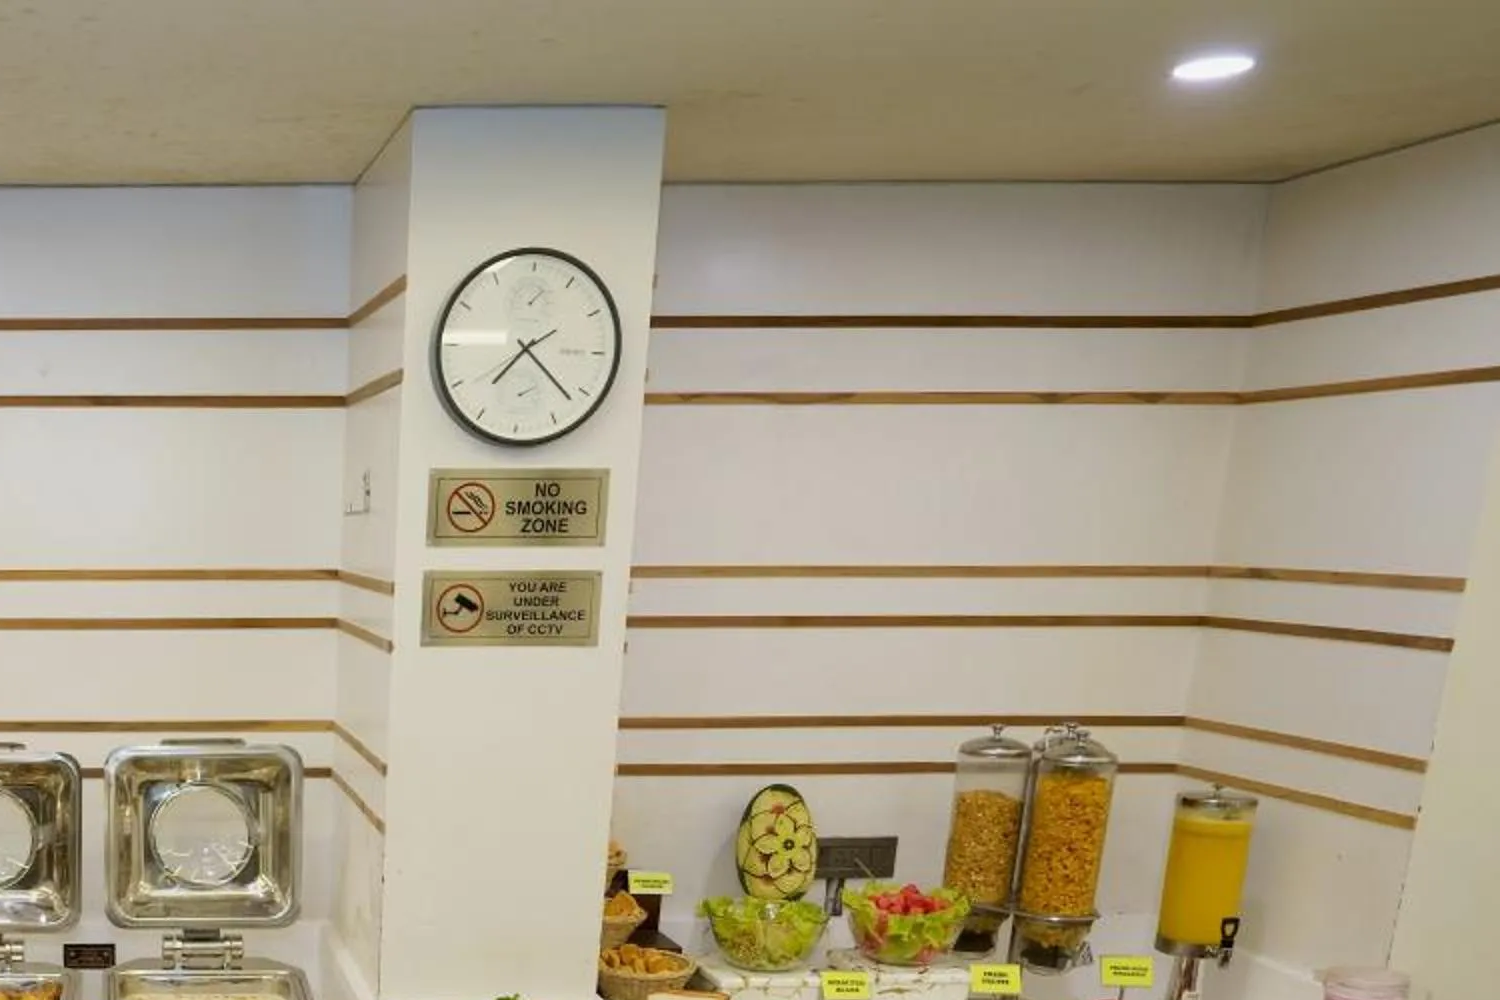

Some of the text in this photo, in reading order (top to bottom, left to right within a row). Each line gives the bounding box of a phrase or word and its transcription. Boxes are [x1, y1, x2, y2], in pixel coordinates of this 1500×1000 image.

[534, 482, 561, 498] NO
[504, 500, 588, 516] SMOKING
[520, 517, 569, 534] ZONE
[509, 581, 568, 593] YOU ARE
[513, 596, 560, 607] UNDER
[485, 609, 586, 622] SURVEILLANCE
[506, 623, 565, 635] OF CCTV
